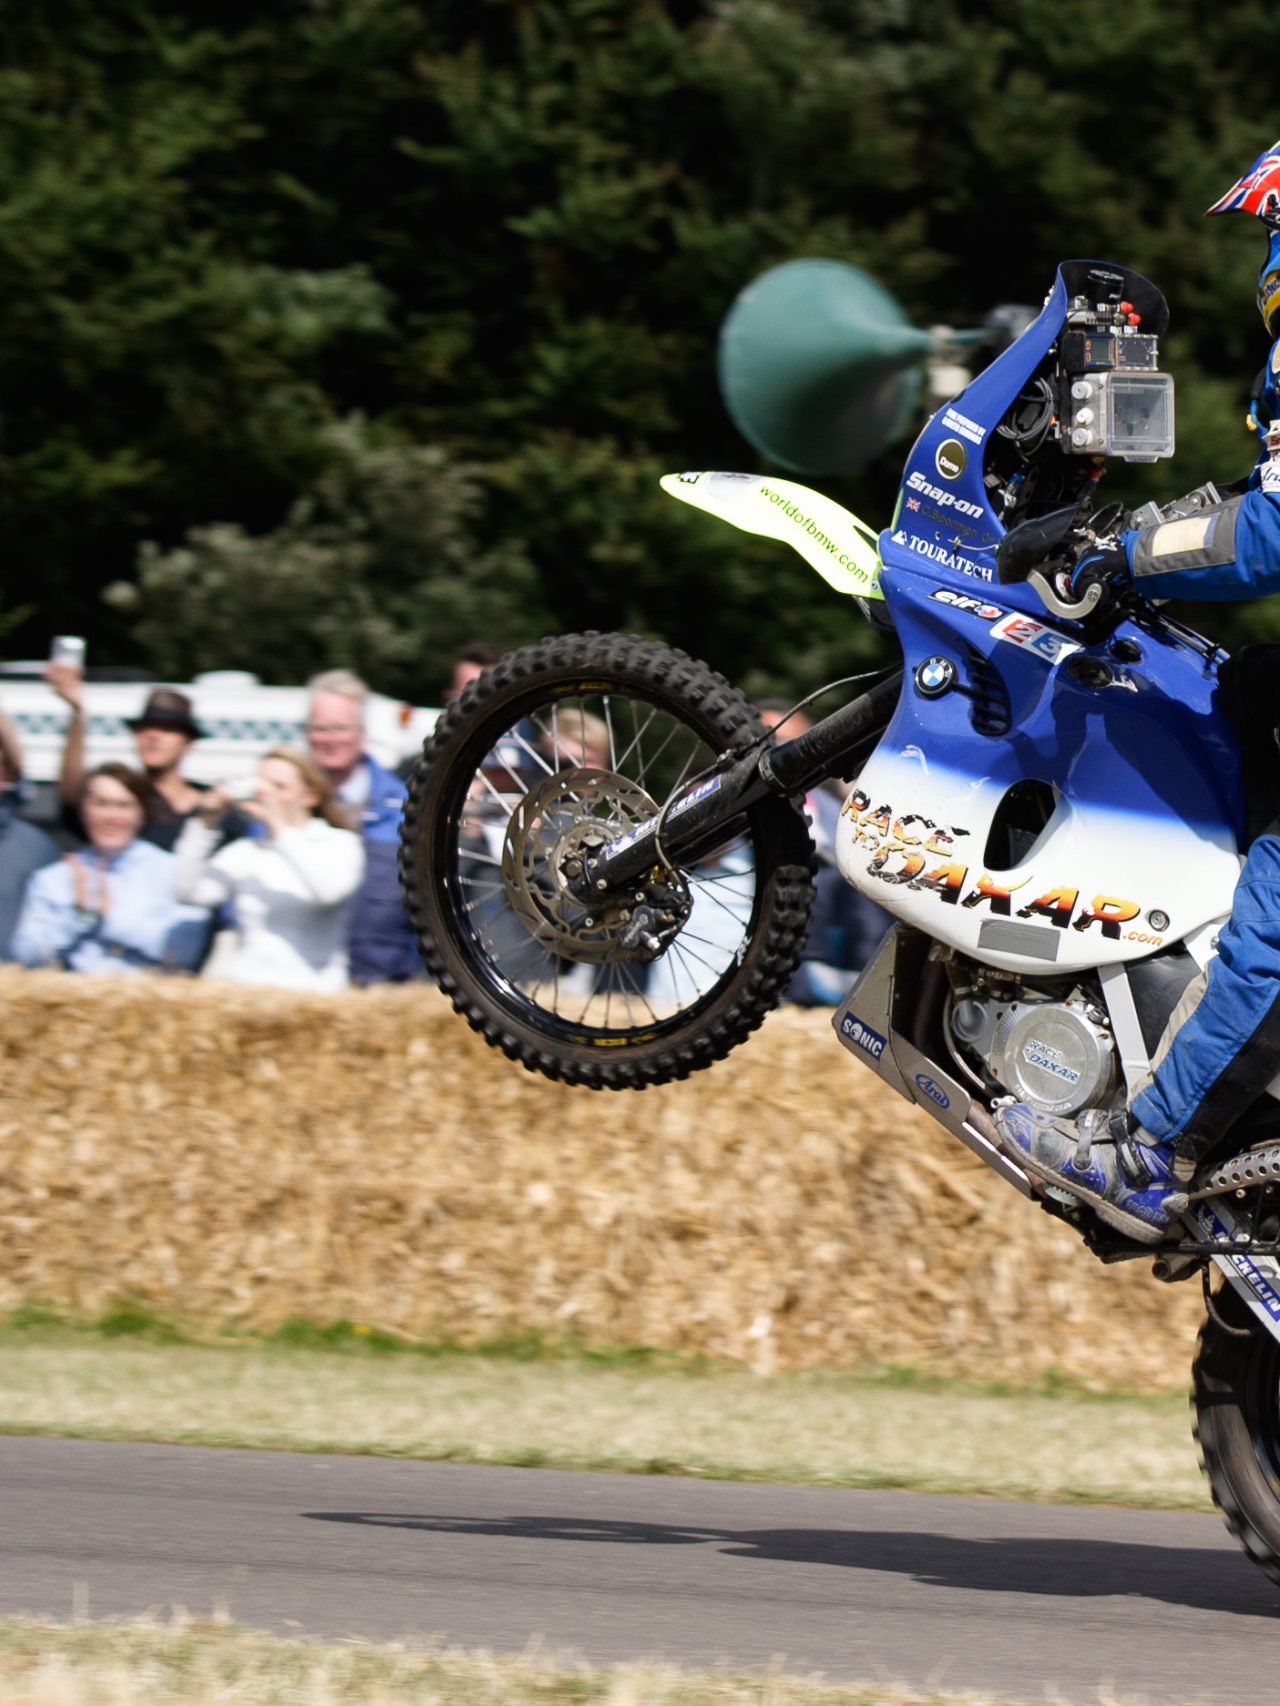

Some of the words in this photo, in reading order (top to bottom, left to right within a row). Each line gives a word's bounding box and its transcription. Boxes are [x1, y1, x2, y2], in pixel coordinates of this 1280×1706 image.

[906, 471, 984, 519] Snap-on
[759, 486, 869, 583] worldofbmw.com
[908, 534, 993, 582] TOURATECH
[934, 589, 979, 610] elf
[842, 788, 970, 857] RACE
[866, 842, 1141, 941] DAKAR
[842, 1018, 883, 1057] SONIC
[1030, 1054, 1078, 1081] DAKAR
[918, 1077, 948, 1107] Arai
